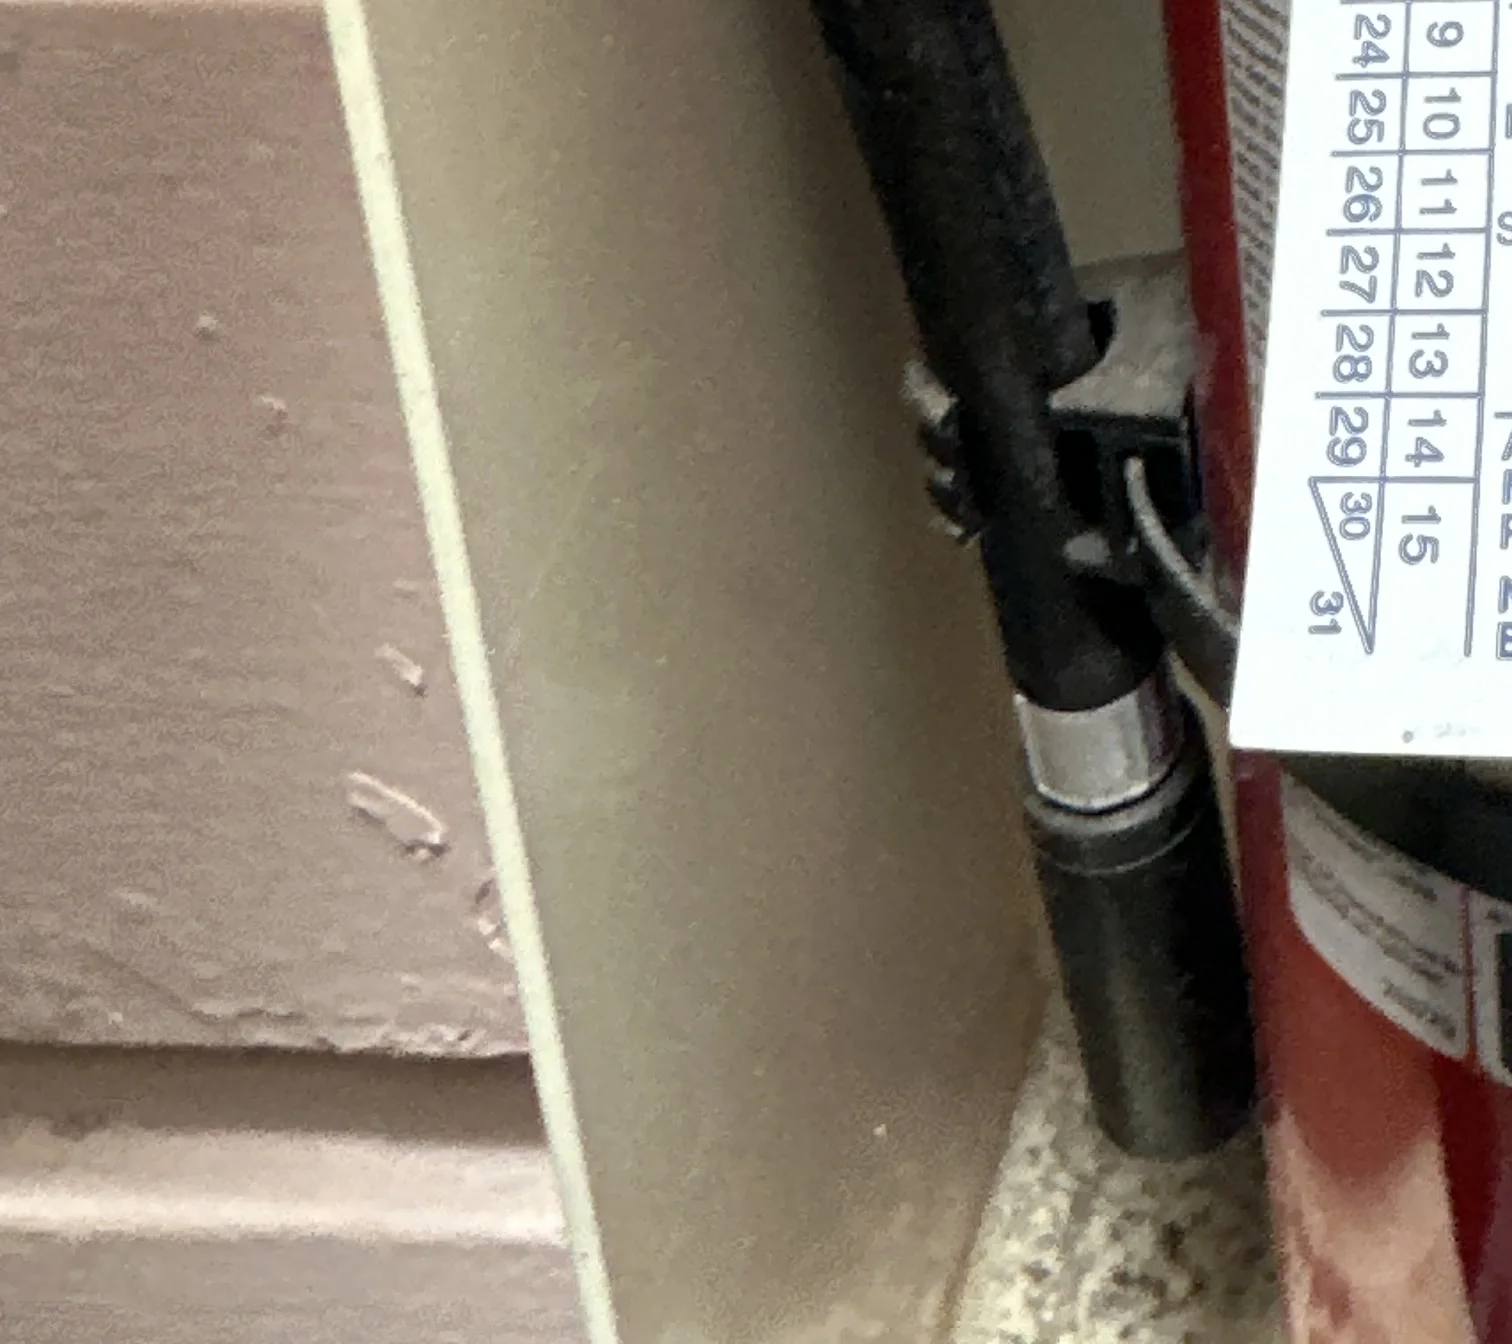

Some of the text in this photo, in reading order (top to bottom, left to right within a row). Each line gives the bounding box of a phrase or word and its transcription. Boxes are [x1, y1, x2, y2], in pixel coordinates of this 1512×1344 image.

[1351, 13, 1392, 69] 24
[1425, 20, 1464, 48] 9
[1346, 89, 1387, 145] 25
[1422, 87, 1462, 140] 10
[1343, 165, 1384, 223] 26
[1418, 169, 1458, 215] 11
[1339, 244, 1380, 304] 27
[1414, 242, 1456, 298] 12
[1333, 324, 1375, 383] 28
[1409, 322, 1450, 380] 13
[1326, 406, 1370, 468] 29
[1405, 409, 1447, 468] 14
[1339, 491, 1373, 541] 30
[1399, 505, 1442, 566] 15
[1308, 589, 1345, 635] 31
